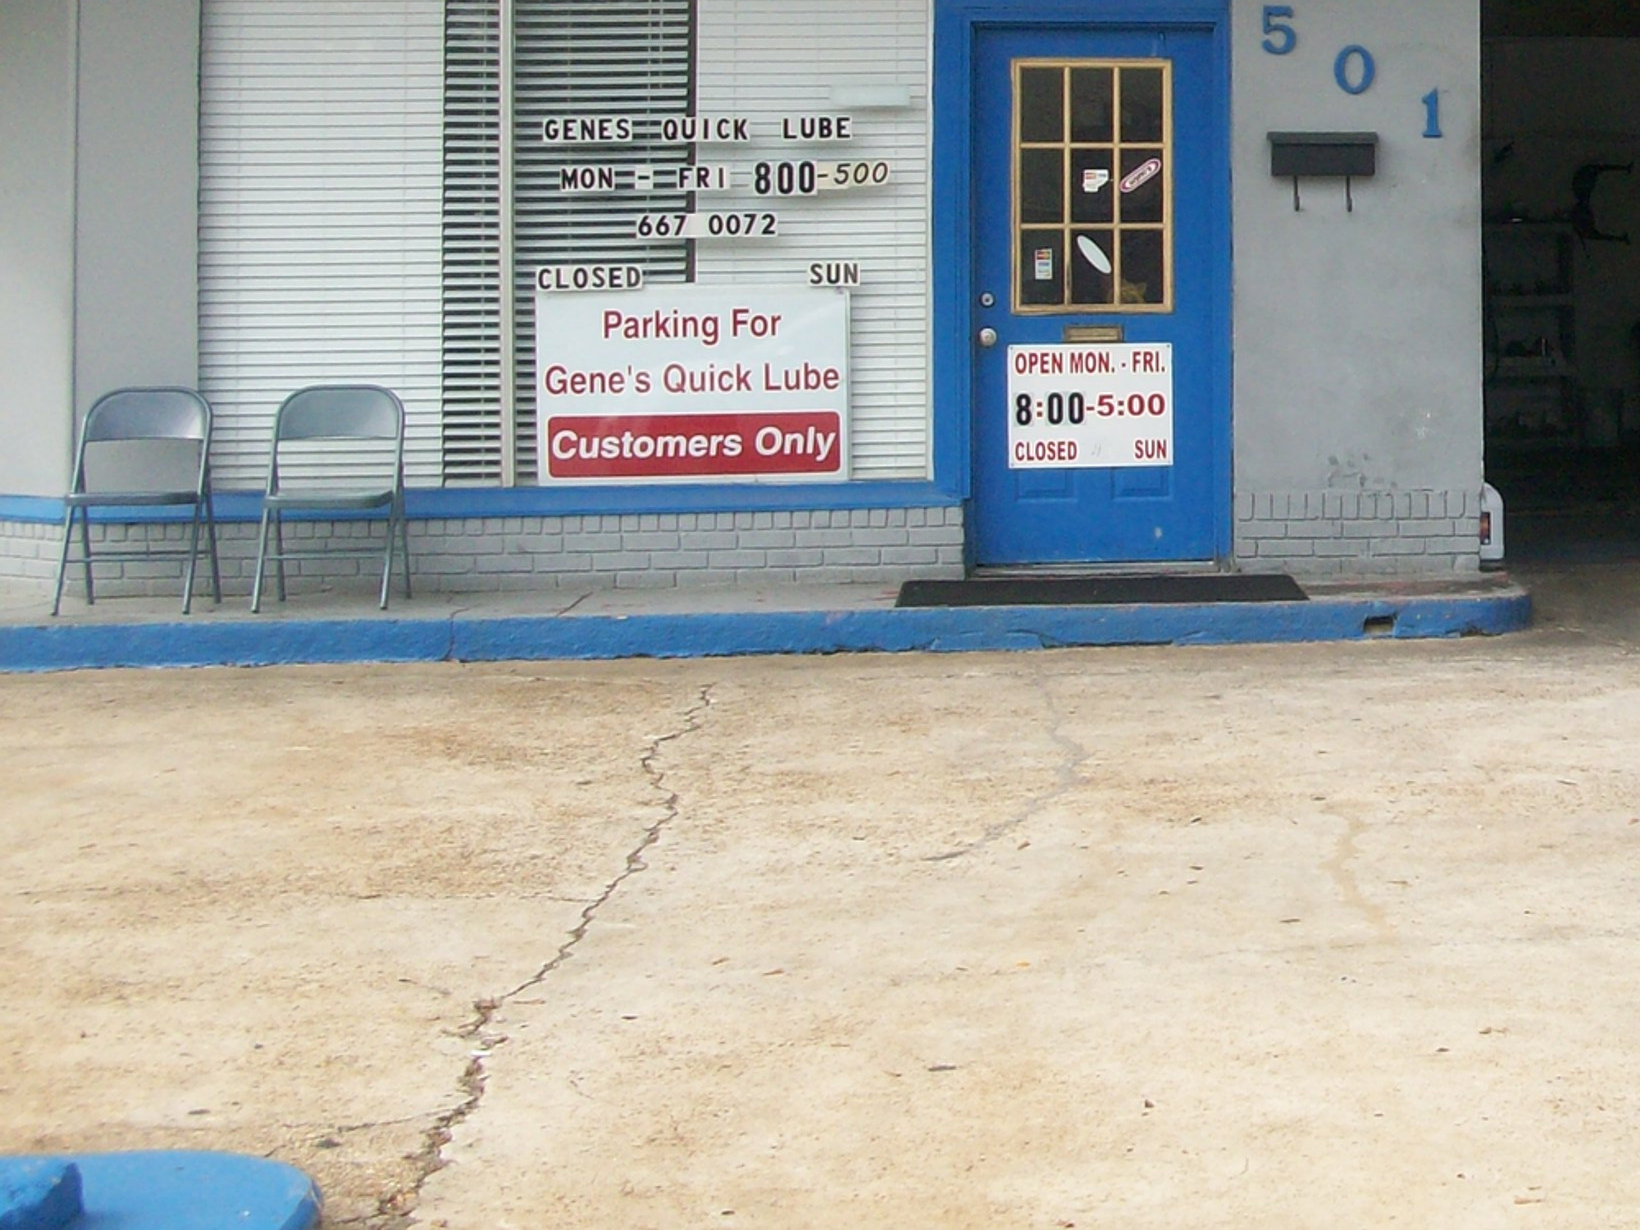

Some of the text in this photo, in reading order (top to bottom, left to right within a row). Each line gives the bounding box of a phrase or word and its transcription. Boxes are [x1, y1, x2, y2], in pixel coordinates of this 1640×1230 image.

[543, 116, 851, 141] GENES QUICK LUBE
[560, 167, 615, 190] MON
[678, 167, 727, 189] FRI
[637, 214, 777, 237] 667 0072
[537, 263, 860, 289] CLOSED SUN
[602, 308, 782, 345] Parking For
[1015, 352, 1063, 374] OPEN
[1069, 352, 1115, 374] MON.
[1132, 351, 1166, 373] FRI.
[544, 362, 841, 395] Gene's Quick Lube
[551, 426, 837, 462] Customers Only
[1015, 439, 1167, 461] CLOSED SUN
